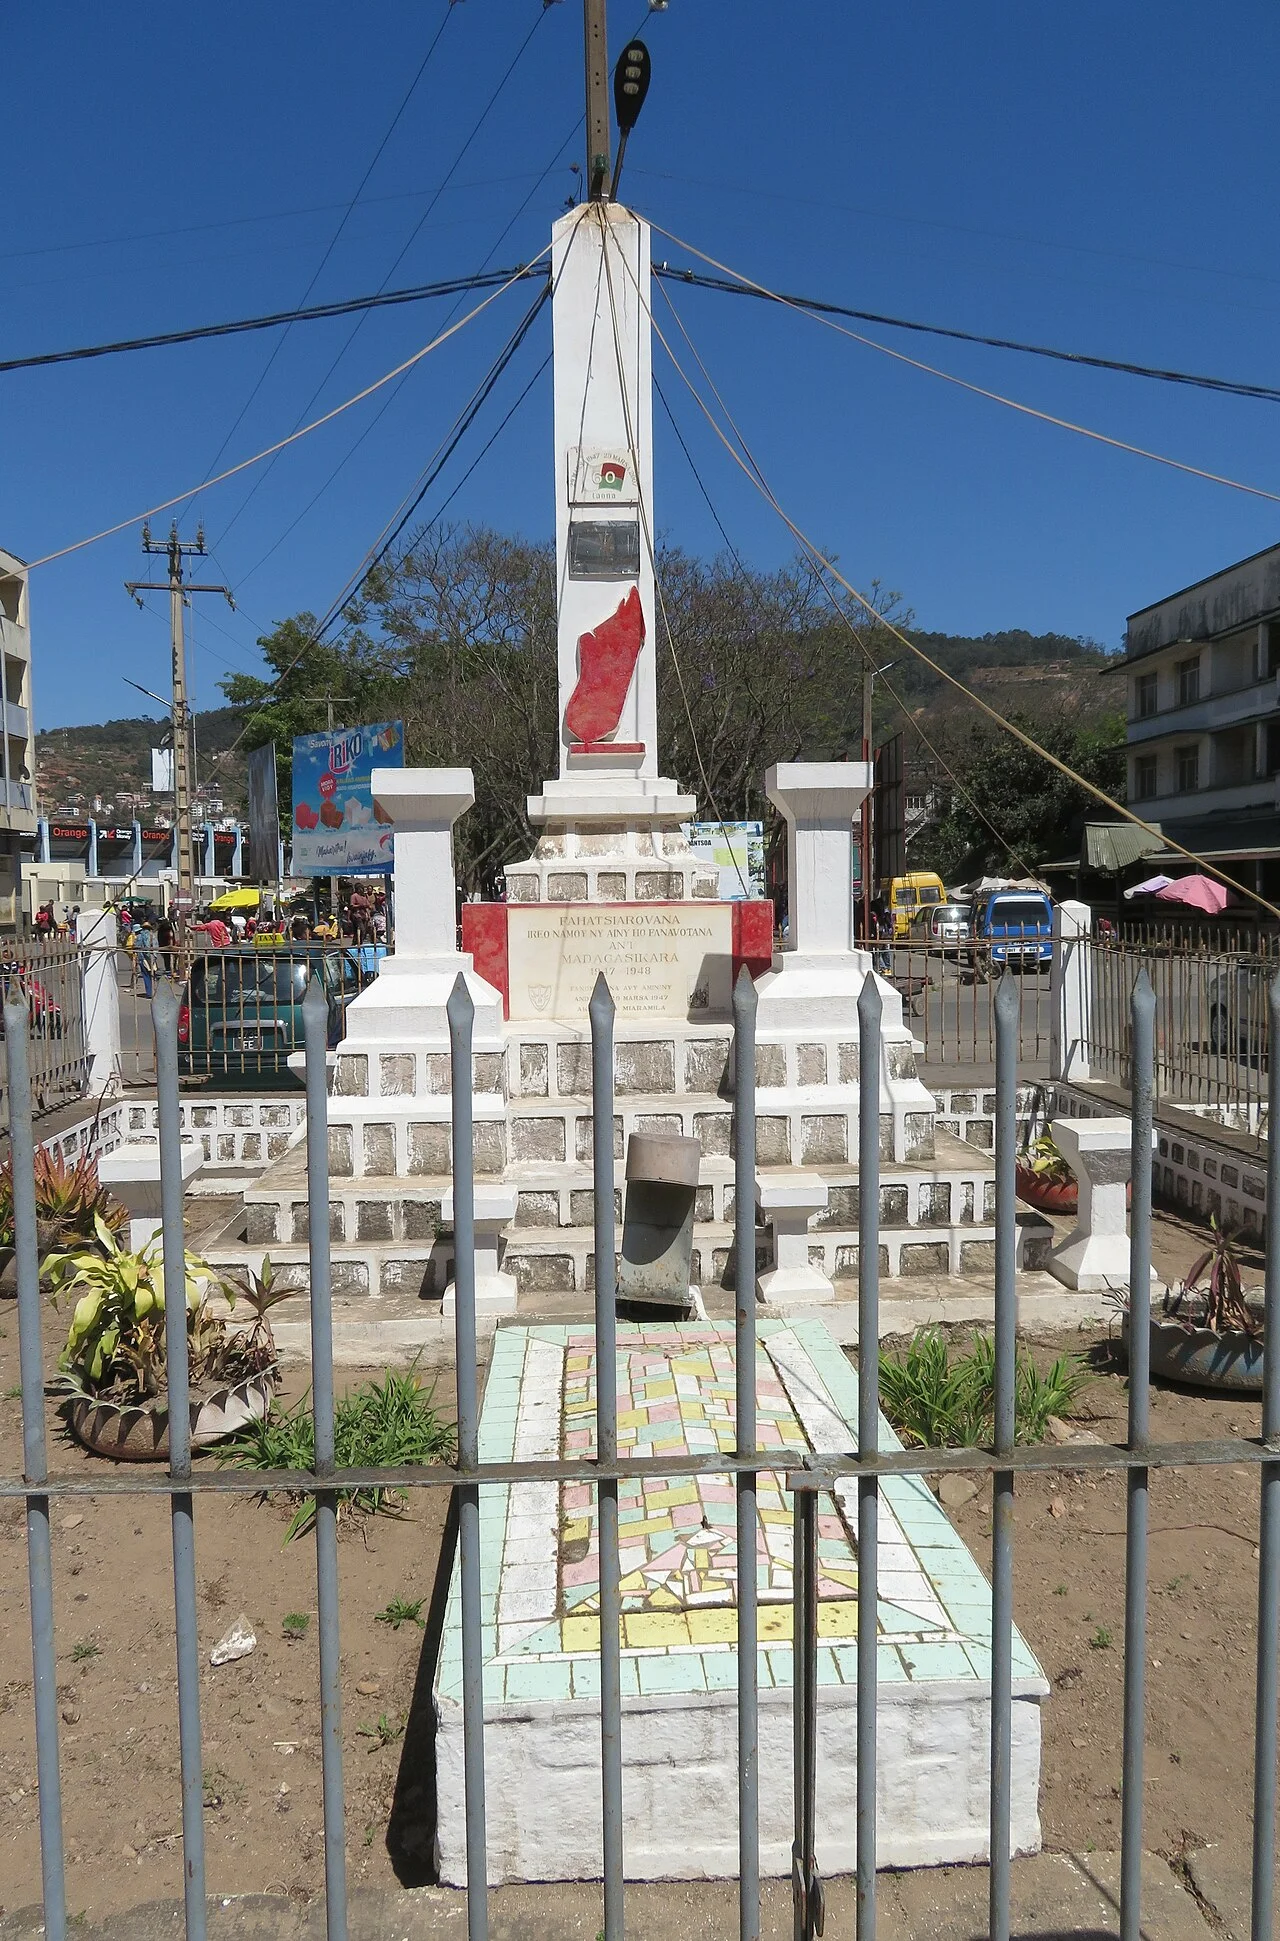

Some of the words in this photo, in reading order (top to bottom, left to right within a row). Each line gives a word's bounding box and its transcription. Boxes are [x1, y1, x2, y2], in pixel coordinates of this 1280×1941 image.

[592, 471, 616, 484] 60
[53, 827, 88, 839] Orange
[559, 915, 681, 926] FAHATSIAROVANA
[527, 930, 550, 938] IREO
[552, 930, 586, 938] NAMOY
[589, 930, 603, 938] NY
[606, 929, 630, 937] AINY
[632, 929, 646, 937] HO
[648, 928, 713, 937] FANAVOTANA
[561, 952, 679, 964] MADAGASIKARA
[625, 966, 652, 976] 1948
[622, 1004, 666, 1012] MIARAMILA
